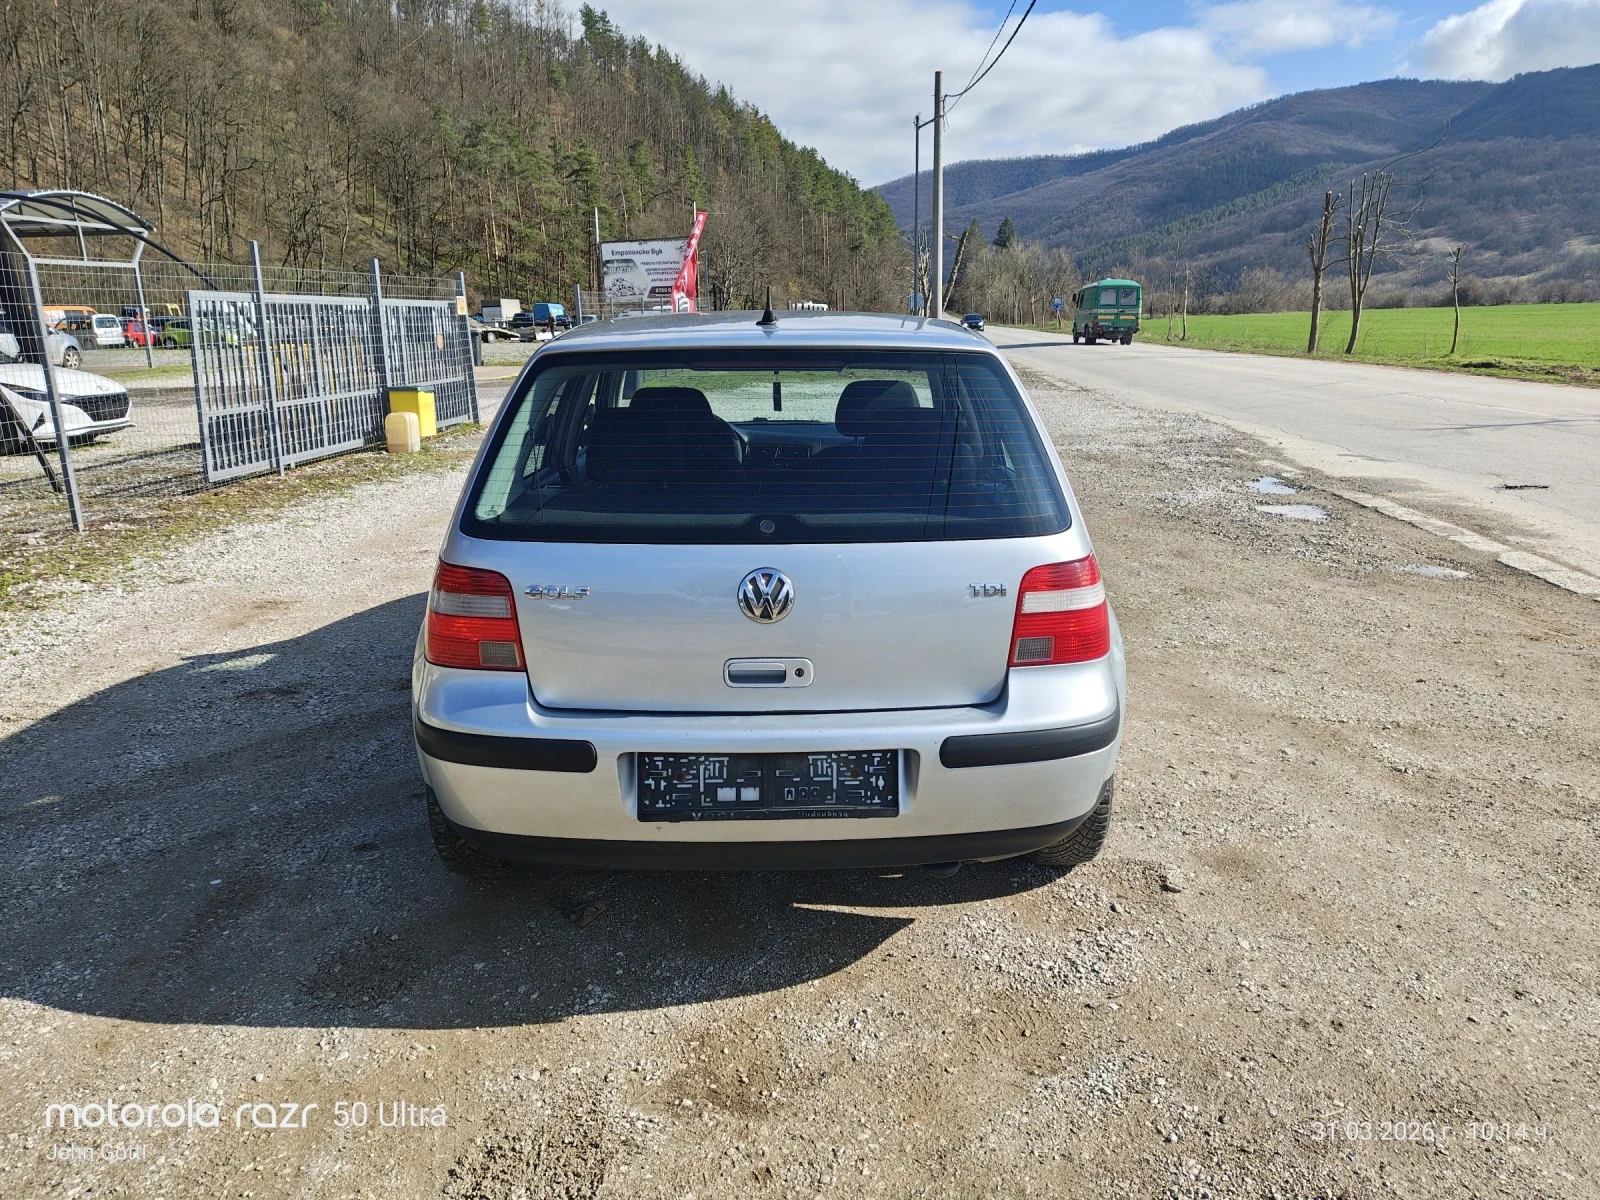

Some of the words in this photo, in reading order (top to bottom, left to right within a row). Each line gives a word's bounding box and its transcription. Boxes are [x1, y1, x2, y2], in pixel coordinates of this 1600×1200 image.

[611, 249, 650, 257] Етрополски
[651, 248, 663, 256] Бук
[524, 585, 590, 600] GOLF
[968, 582, 1007, 597] TDI
